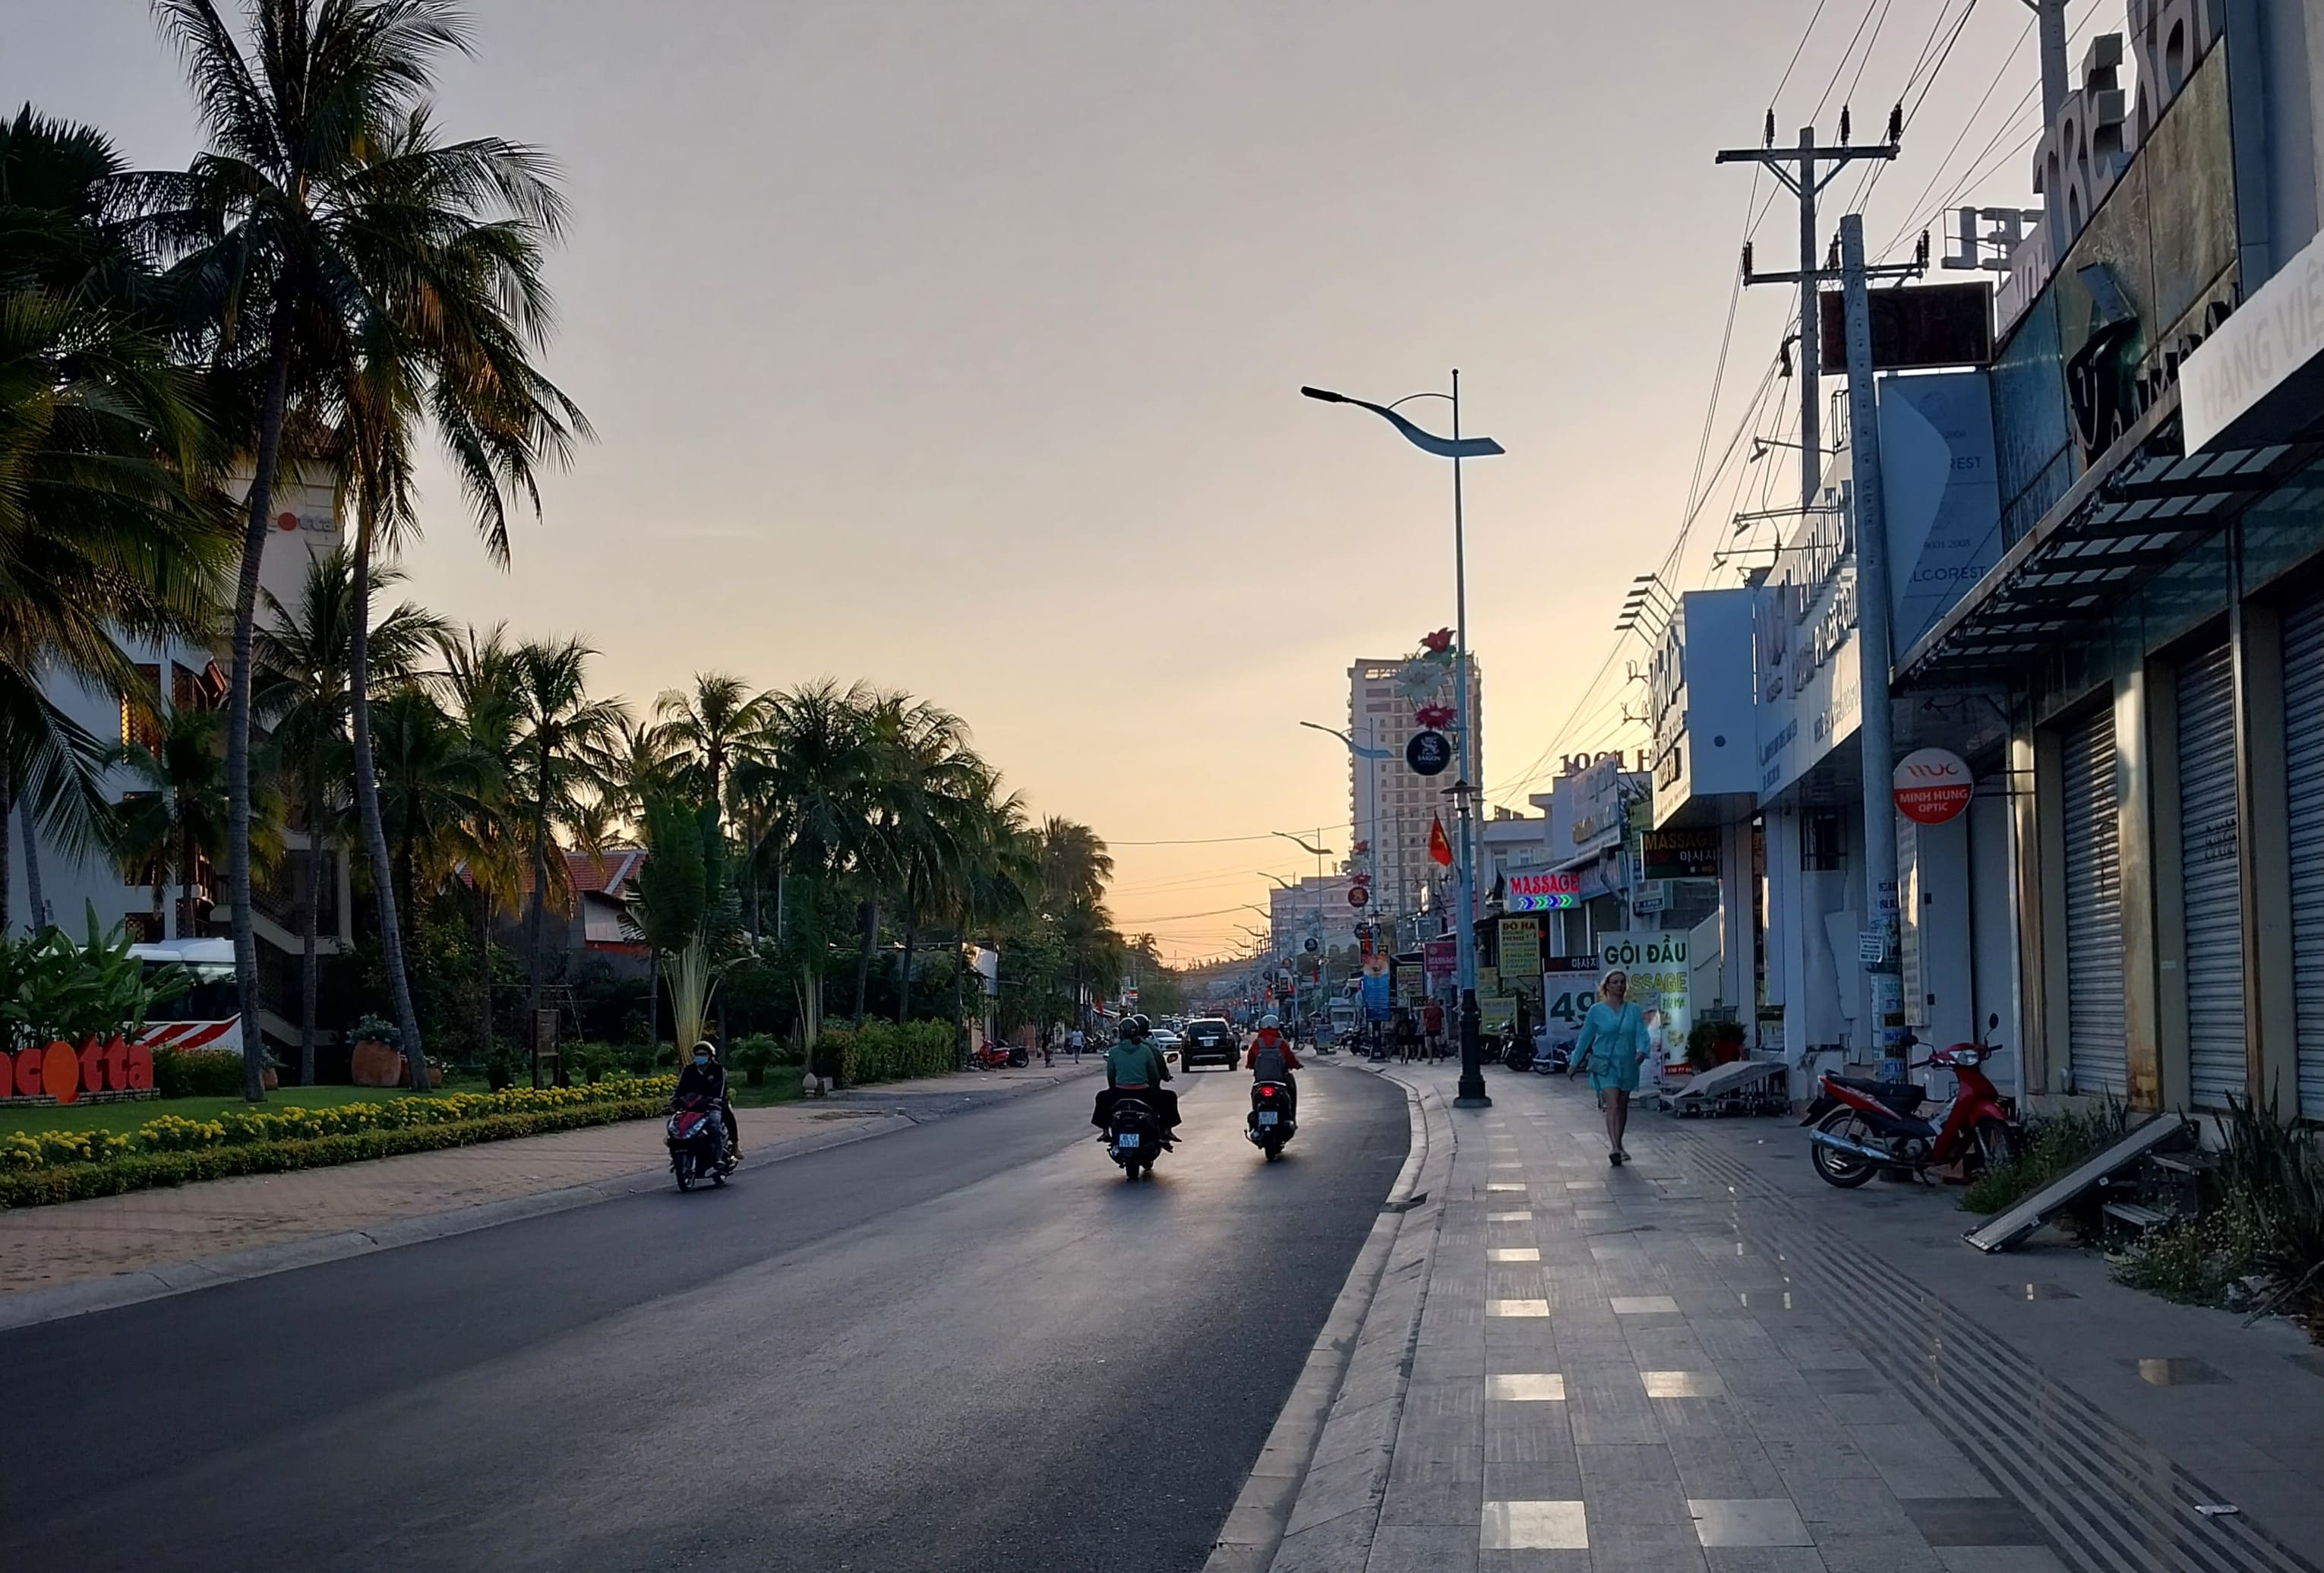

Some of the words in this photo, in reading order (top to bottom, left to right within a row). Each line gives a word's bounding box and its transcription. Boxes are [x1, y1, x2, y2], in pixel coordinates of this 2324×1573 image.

[1899, 791, 1931, 803] MINH
[1933, 789, 1968, 801] HUNG
[1918, 802, 1948, 813] OPTIC
[1680, 849, 1716, 862] 마사지
[1510, 874, 1580, 895] MASSAGE
[1604, 940, 1640, 970] GỘI
[1647, 934, 1686, 964] ĐẦU
[1630, 971, 1688, 993] SSAGE
